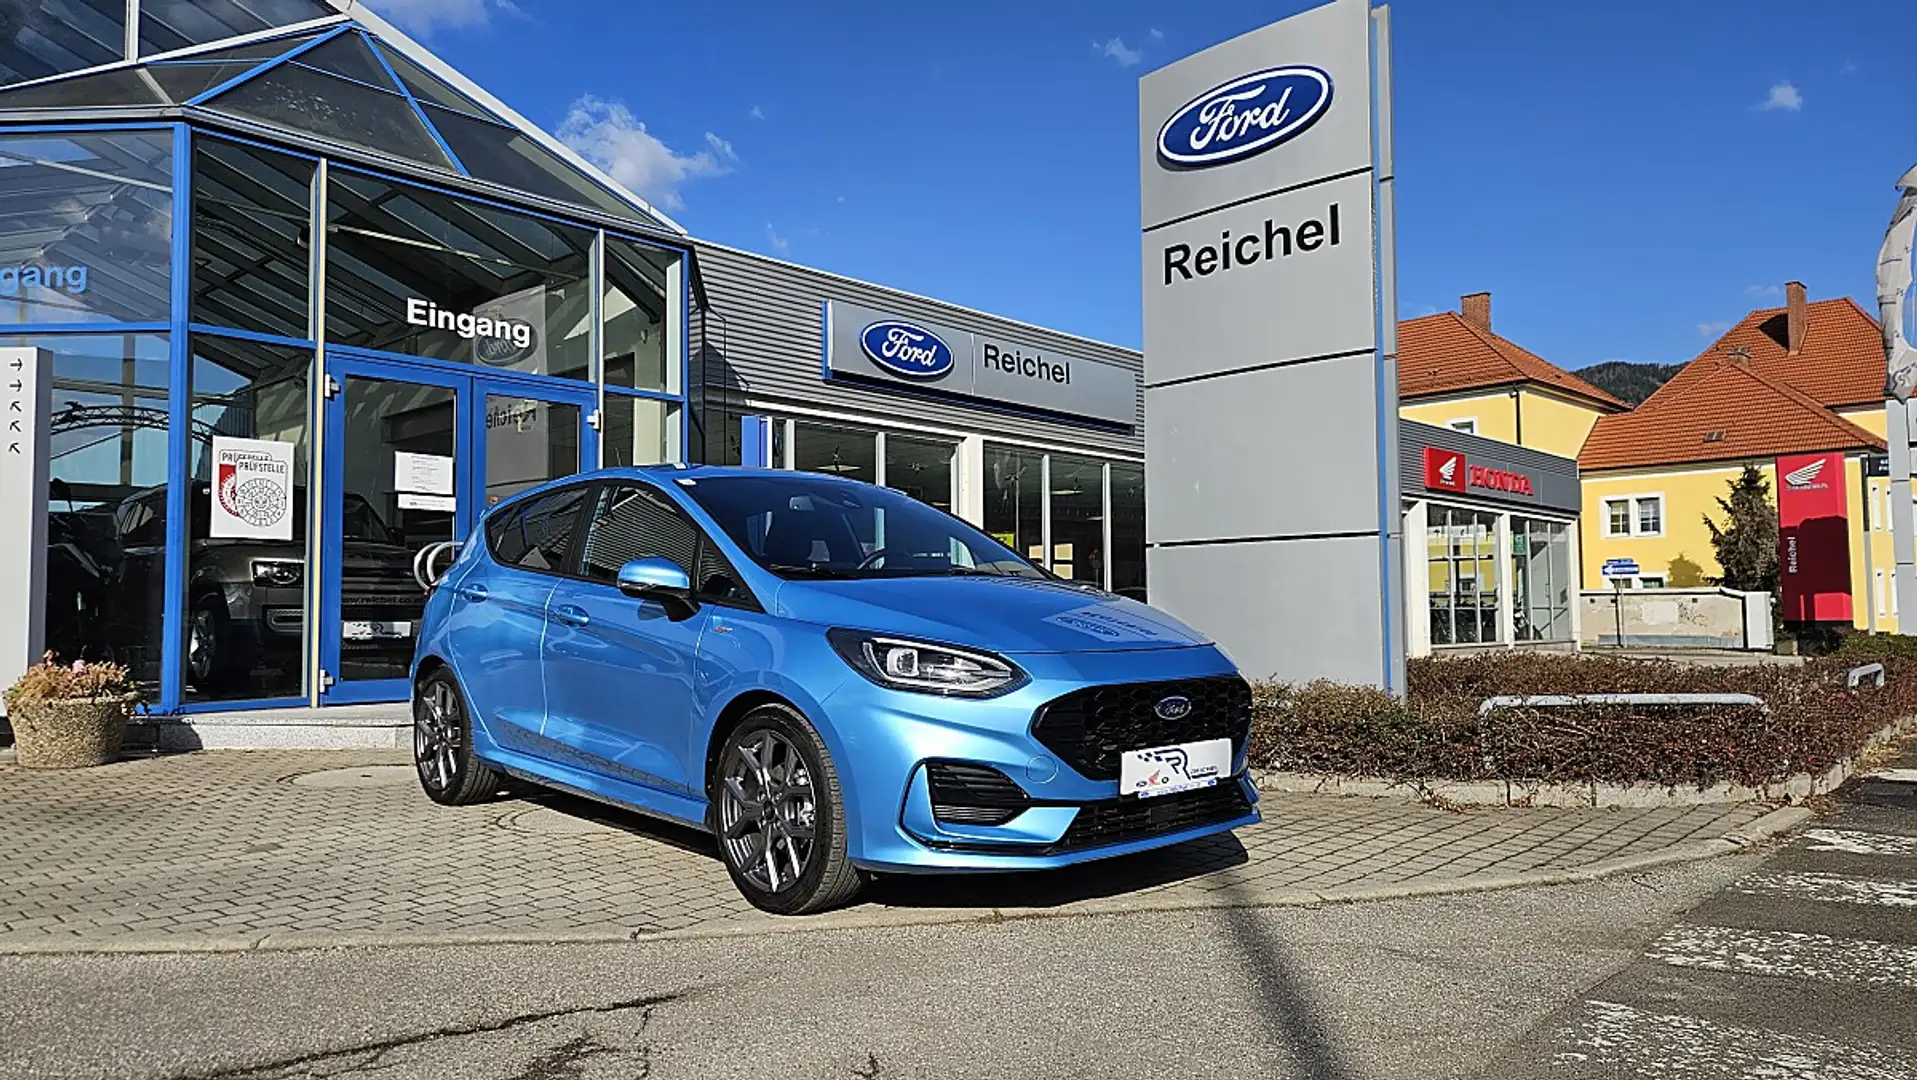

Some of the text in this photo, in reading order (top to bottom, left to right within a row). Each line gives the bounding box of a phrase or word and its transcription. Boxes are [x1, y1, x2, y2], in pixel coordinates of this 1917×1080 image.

[1190, 84, 1293, 150] Ford
[1163, 203, 1340, 286] Reichel
[407, 297, 531, 348] Eingang
[881, 327, 937, 367] Ford
[983, 343, 1071, 384] Reichel
[1469, 464, 1535, 496] HONDA
[1787, 536, 1798, 573] Reichel
